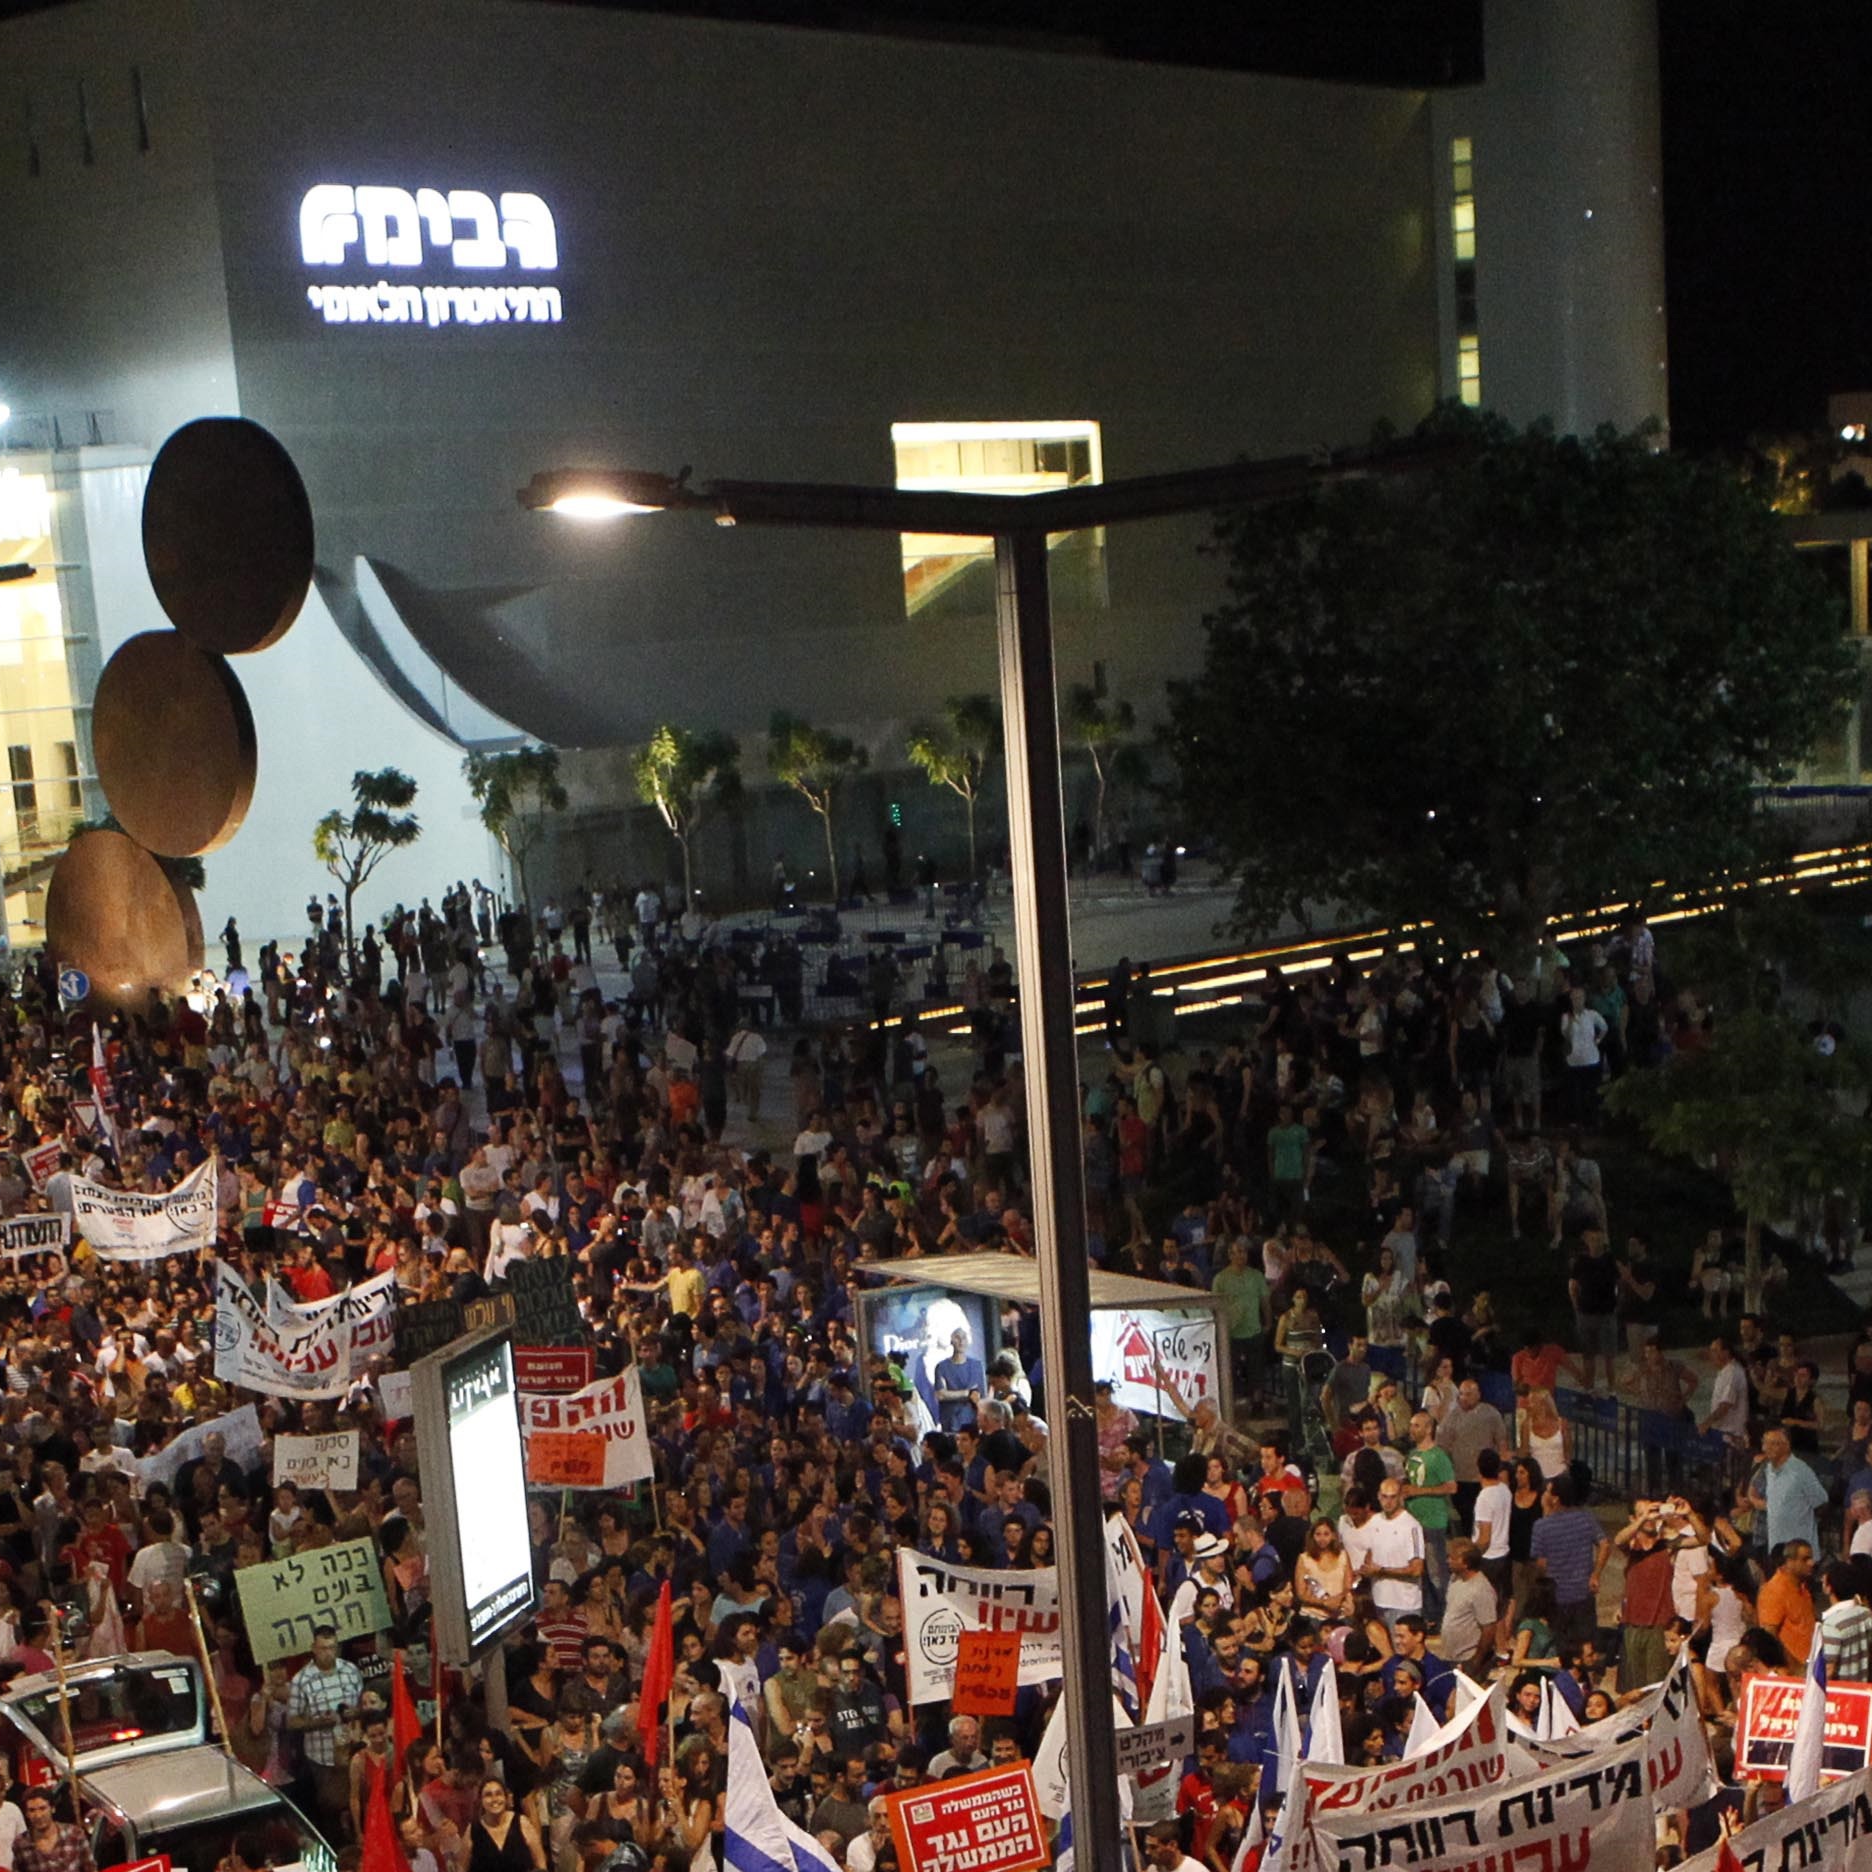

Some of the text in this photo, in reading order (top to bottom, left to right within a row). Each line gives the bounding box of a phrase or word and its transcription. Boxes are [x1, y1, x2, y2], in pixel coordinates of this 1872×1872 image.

[272, 1546, 369, 1592] ככה לא
[313, 1574, 375, 1604] בונים
[941, 1784, 1023, 1816] כשהממשלה
[970, 1798, 1025, 1821] נגד העם
[1498, 1759, 1644, 1837] מדינת
[926, 1813, 1029, 1853] העם נגד
